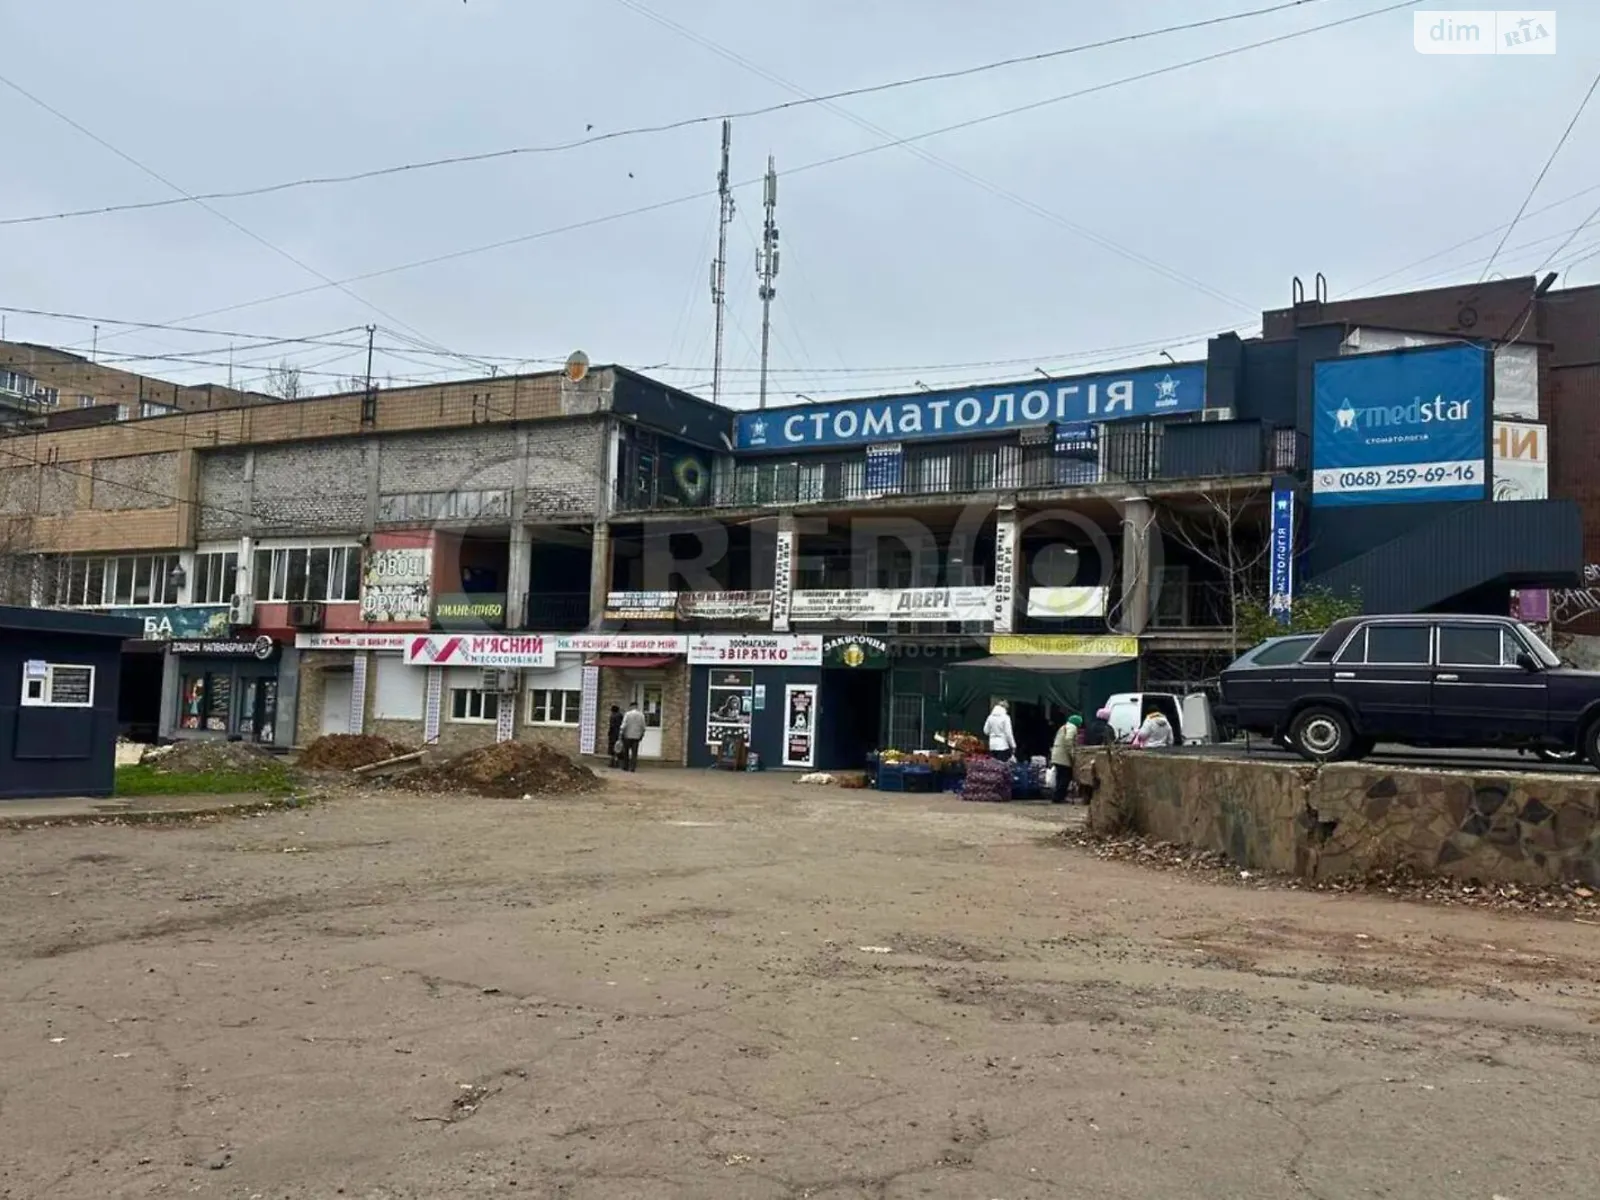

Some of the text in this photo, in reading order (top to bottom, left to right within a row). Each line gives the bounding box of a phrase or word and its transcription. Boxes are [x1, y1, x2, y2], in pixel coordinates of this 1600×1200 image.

[1366, 394, 1472, 428] medstar
[1339, 465, 1475, 488] (068) 259-69-16
[897, 589, 950, 611] ДВЕРІ
[472, 634, 544, 654] М'ЯСНИЙ
[729, 639, 778, 648] ЗООМАГАЗИН
[719, 648, 788, 661] ЗВІРЯТКО
